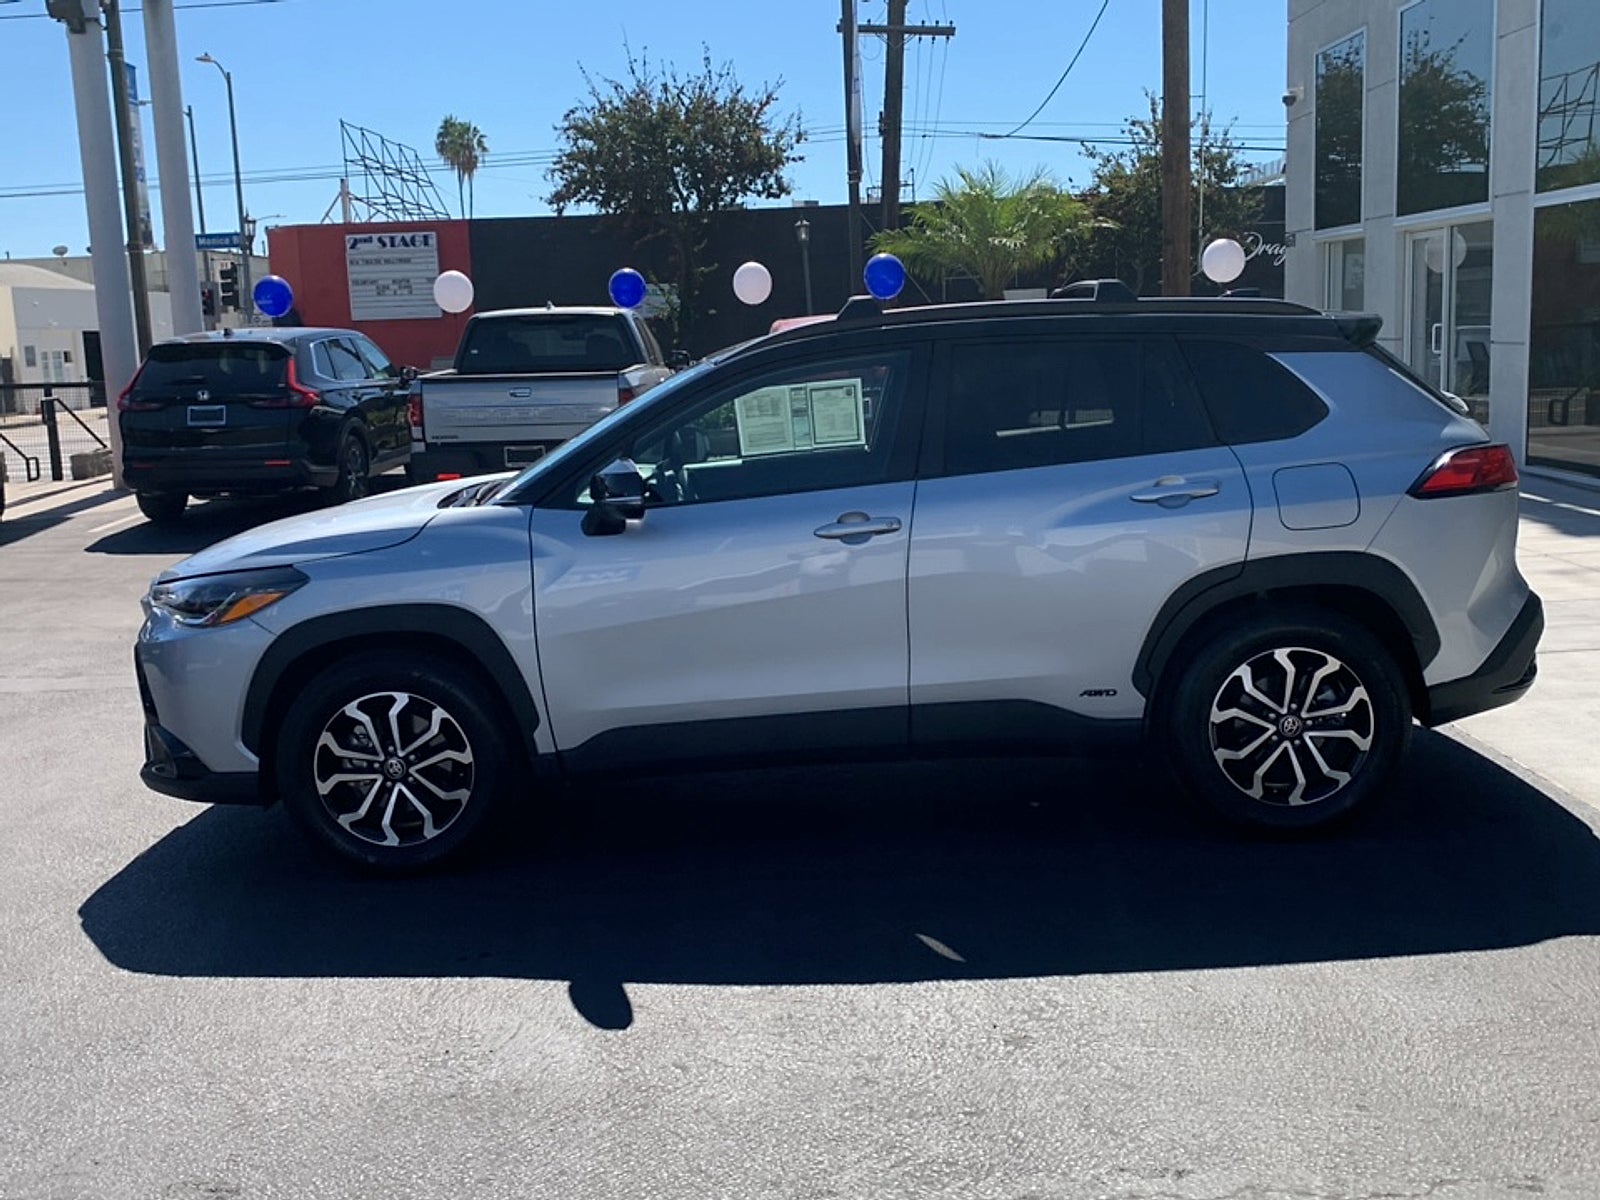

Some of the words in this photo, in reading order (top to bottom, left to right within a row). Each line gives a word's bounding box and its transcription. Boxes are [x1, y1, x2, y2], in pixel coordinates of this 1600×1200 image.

[348, 236, 373, 249] 2nd
[377, 234, 433, 248] STAGE
[1079, 688, 1118, 697] AWD
